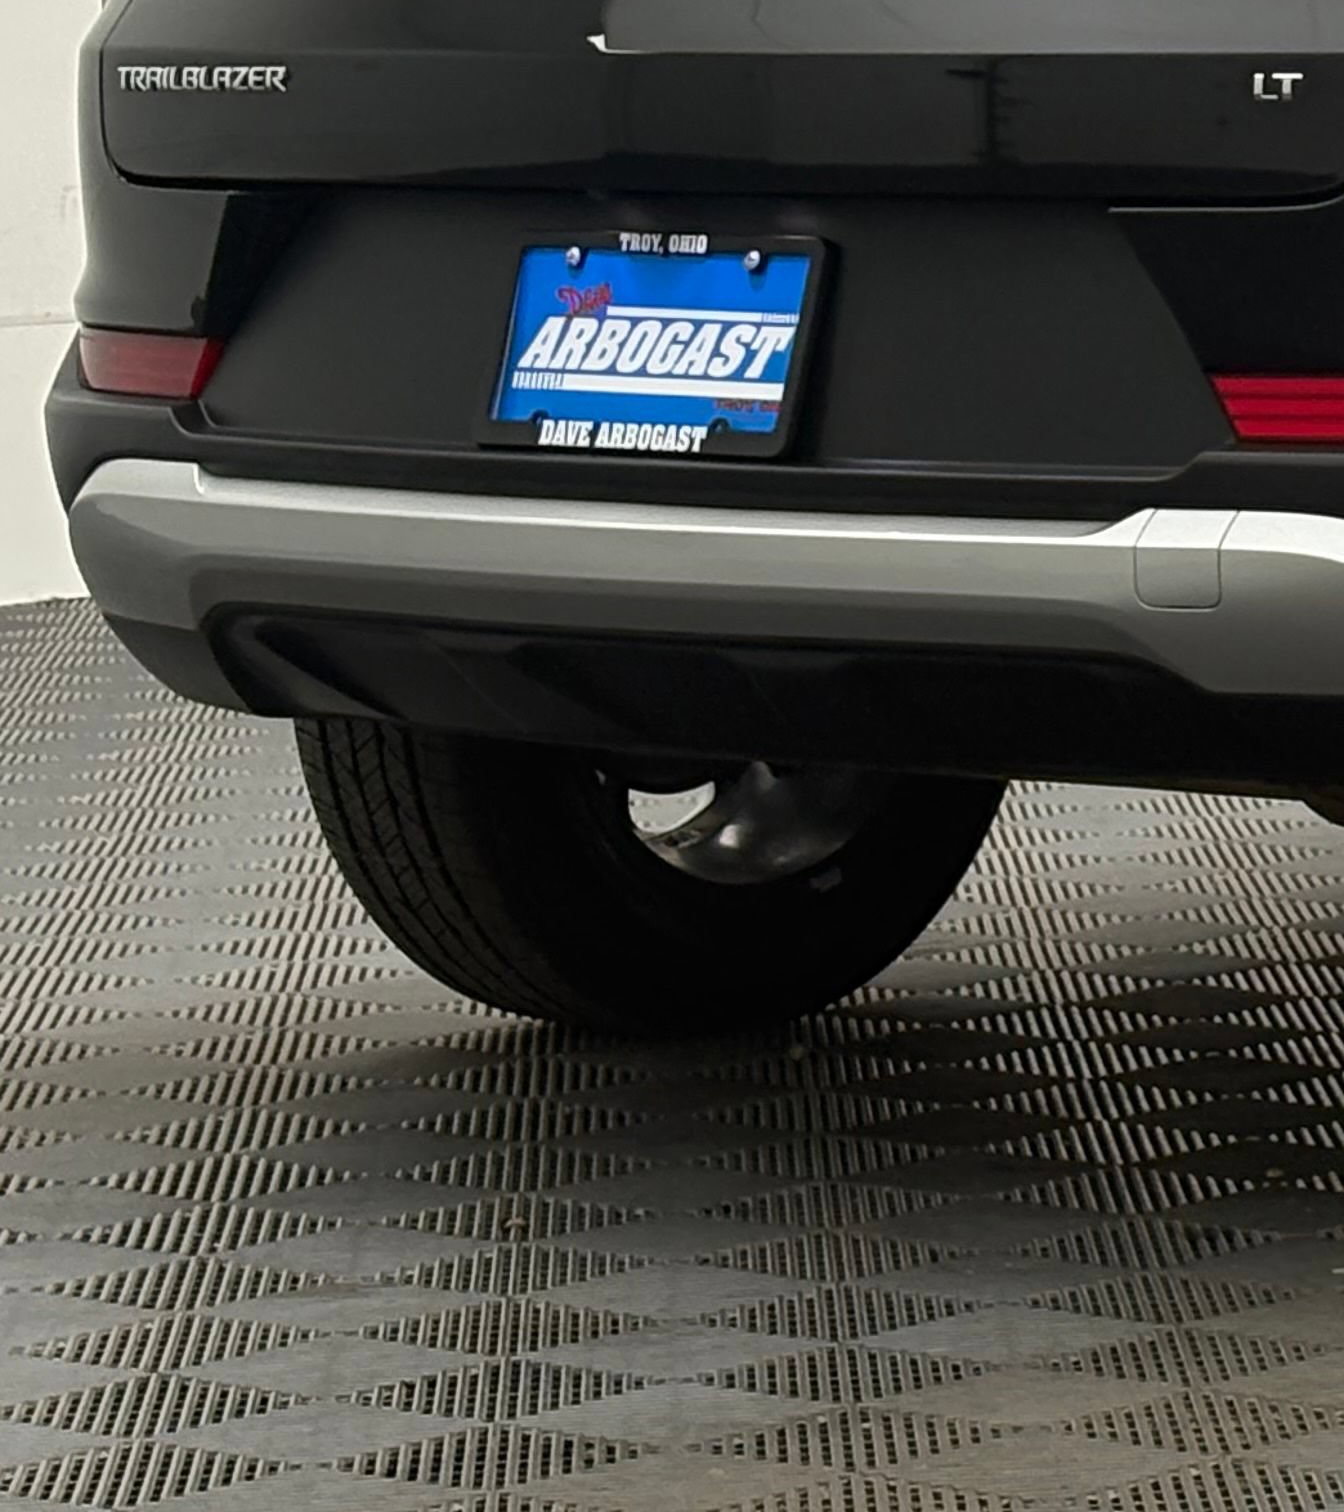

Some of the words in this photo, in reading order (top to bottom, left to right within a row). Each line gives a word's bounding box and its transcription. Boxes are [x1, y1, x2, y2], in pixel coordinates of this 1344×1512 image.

[117, 65, 287, 92] TRAILBLAZER
[1253, 72, 1304, 101] LT
[619, 233, 664, 255] TROY,
[669, 234, 708, 254] OHIO
[517, 315, 796, 380] ARBOGAST
[538, 420, 593, 446] DAVE
[595, 423, 708, 452] ARBOGAST
